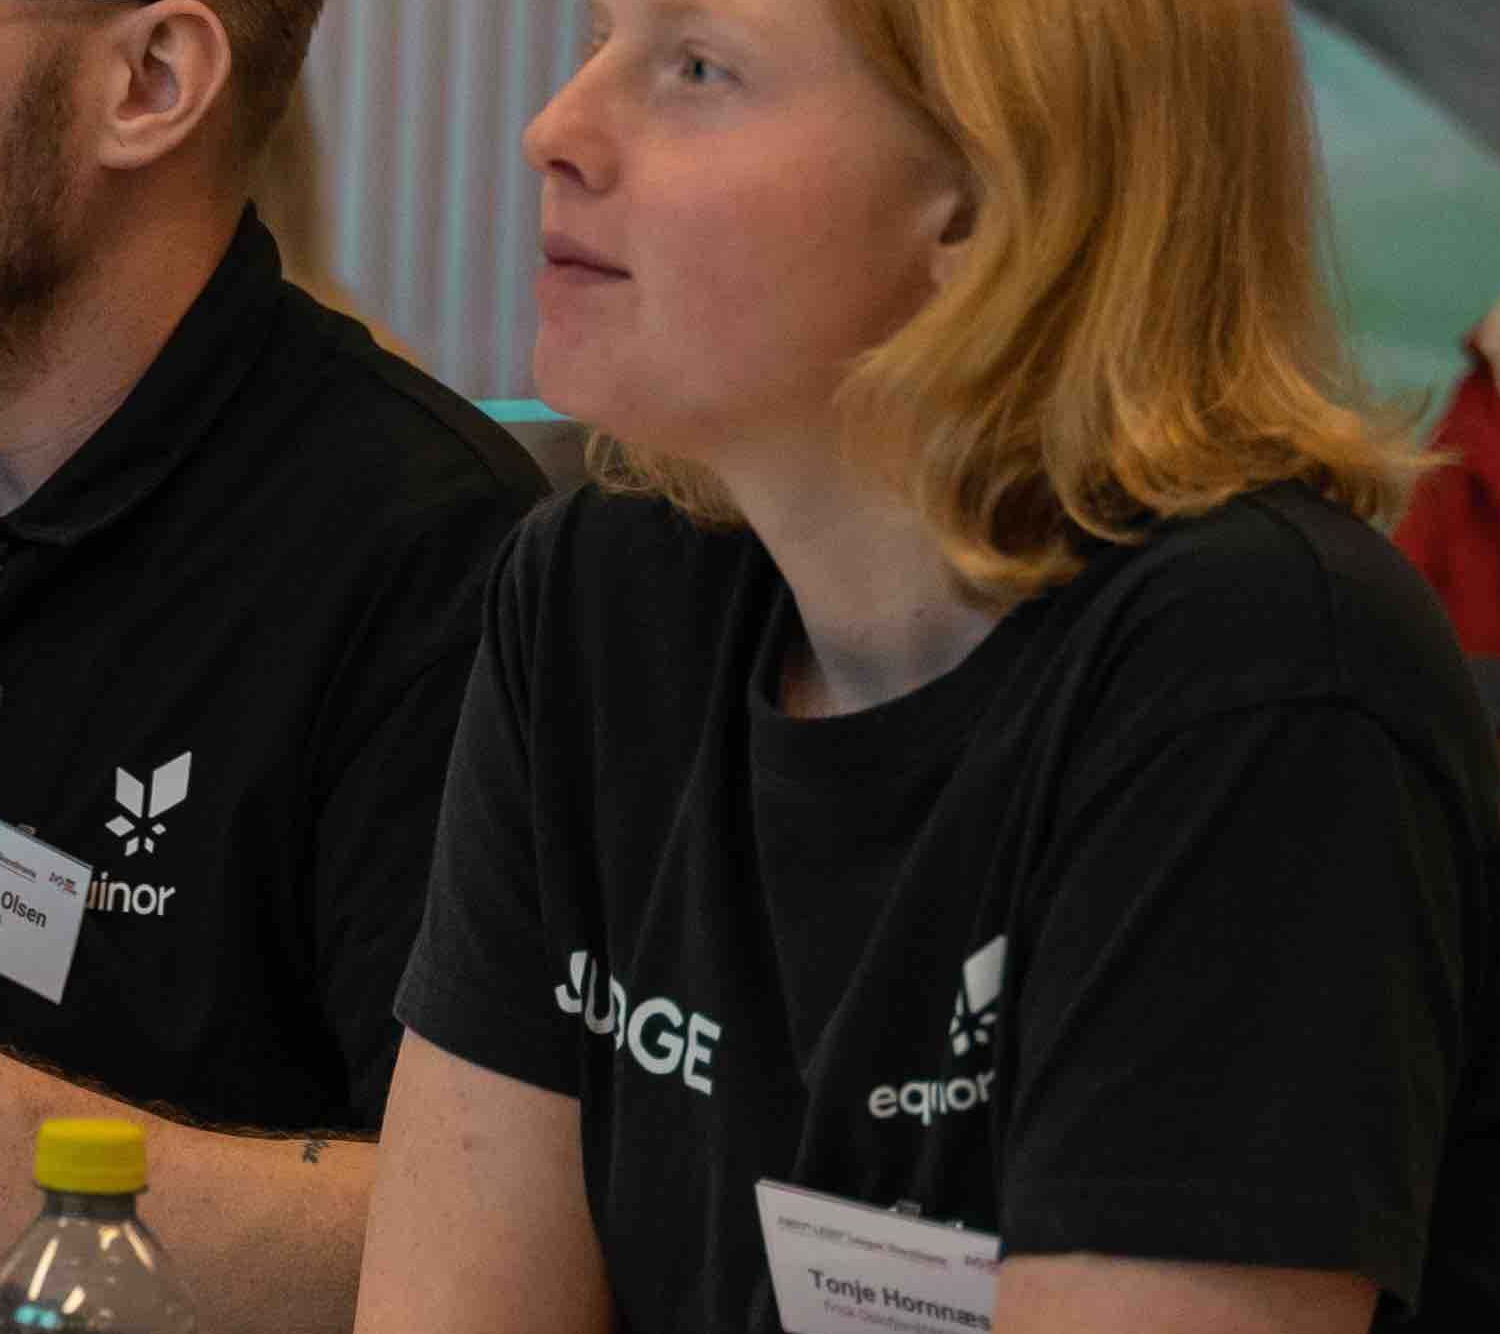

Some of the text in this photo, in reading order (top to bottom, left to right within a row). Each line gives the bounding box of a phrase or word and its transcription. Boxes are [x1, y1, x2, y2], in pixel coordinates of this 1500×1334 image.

[1, 890, 48, 929] Olsen
[86, 870, 177, 917] inor
[807, 1267, 877, 1304] Tonje
